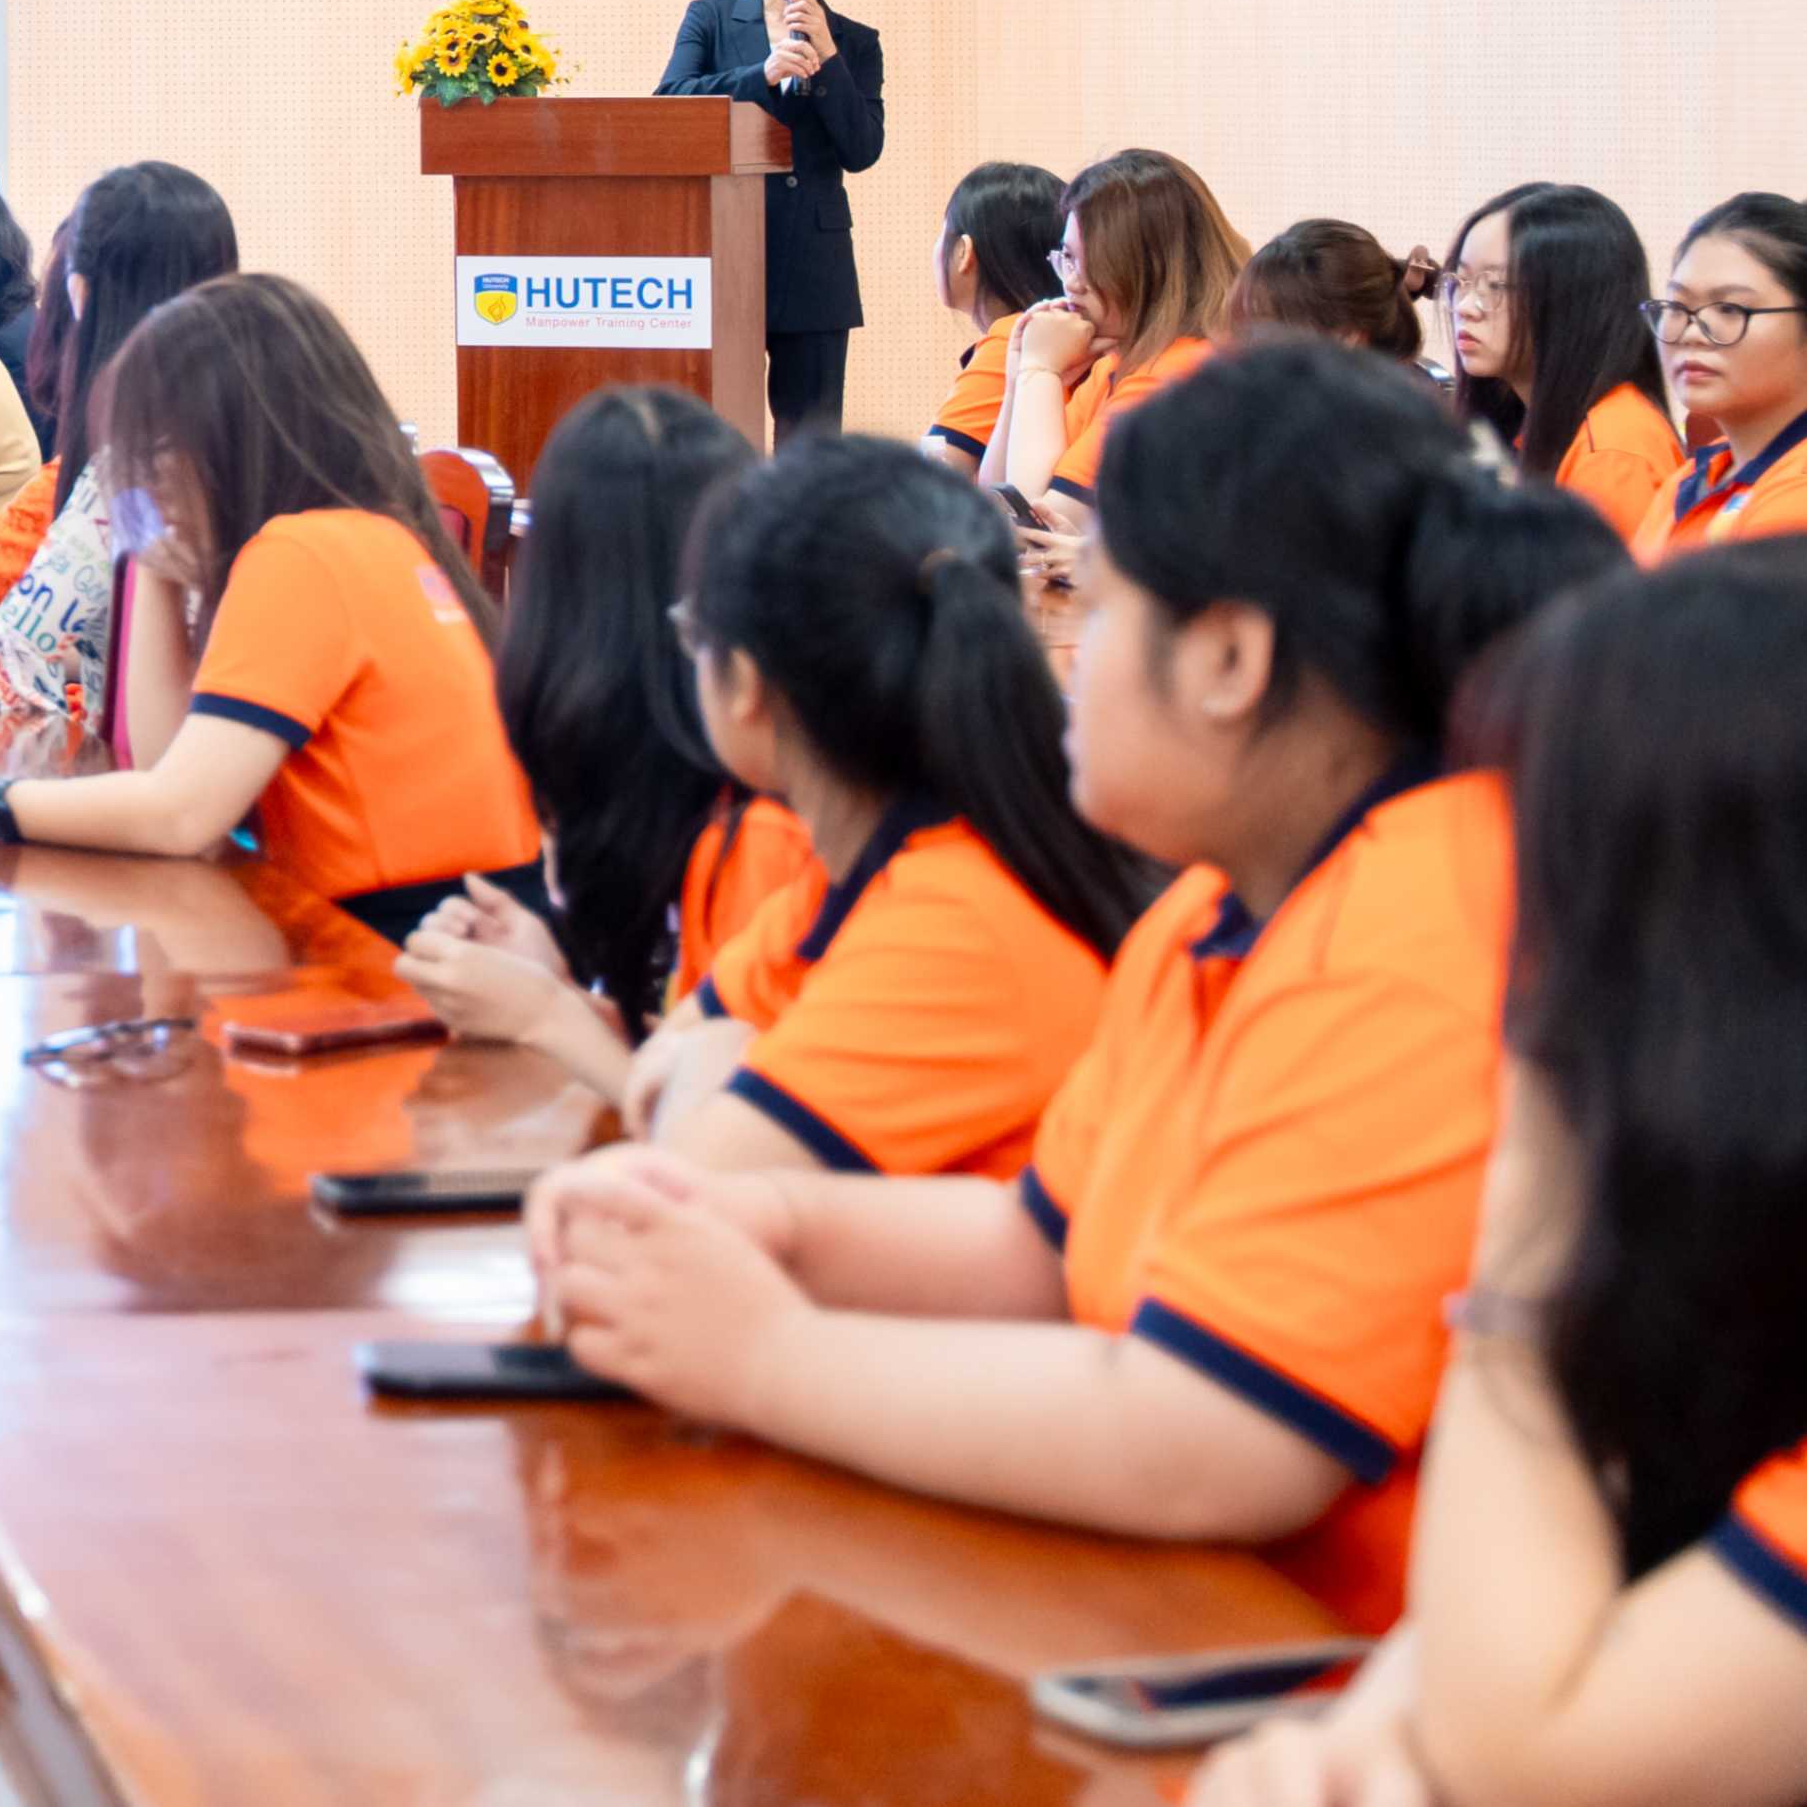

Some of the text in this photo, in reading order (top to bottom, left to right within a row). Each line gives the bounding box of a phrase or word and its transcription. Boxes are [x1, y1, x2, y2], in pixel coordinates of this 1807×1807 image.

[525, 277, 693, 310] HUTECH
[525, 316, 692, 330] Manpower Training Center
